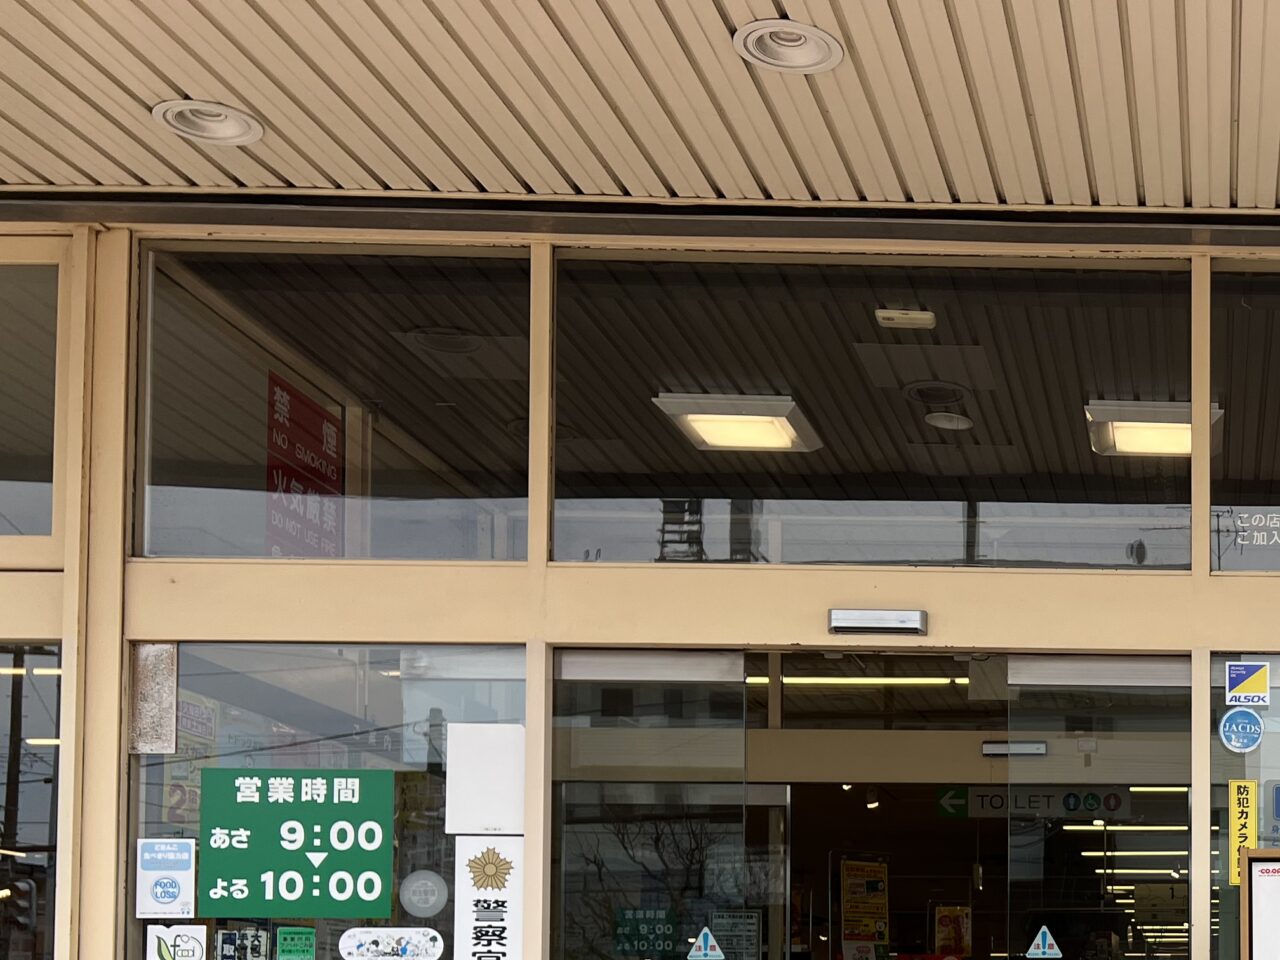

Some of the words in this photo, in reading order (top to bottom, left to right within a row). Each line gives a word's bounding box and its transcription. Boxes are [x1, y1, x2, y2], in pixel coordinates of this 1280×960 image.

[272, 427, 288, 449] NO
[295, 443, 337, 480] SMOKING
[1229, 695, 1267, 703] ALSOK
[1224, 722, 1260, 733] JACDS
[234, 776, 360, 804] 営業時間
[976, 794, 1056, 810] TOLET
[209, 826, 251, 849] あさ
[279, 820, 383, 851] 9:00
[1236, 785, 1250, 877] 防犯カメラ
[208, 878, 249, 900] よる
[260, 870, 383, 901] 10:00
